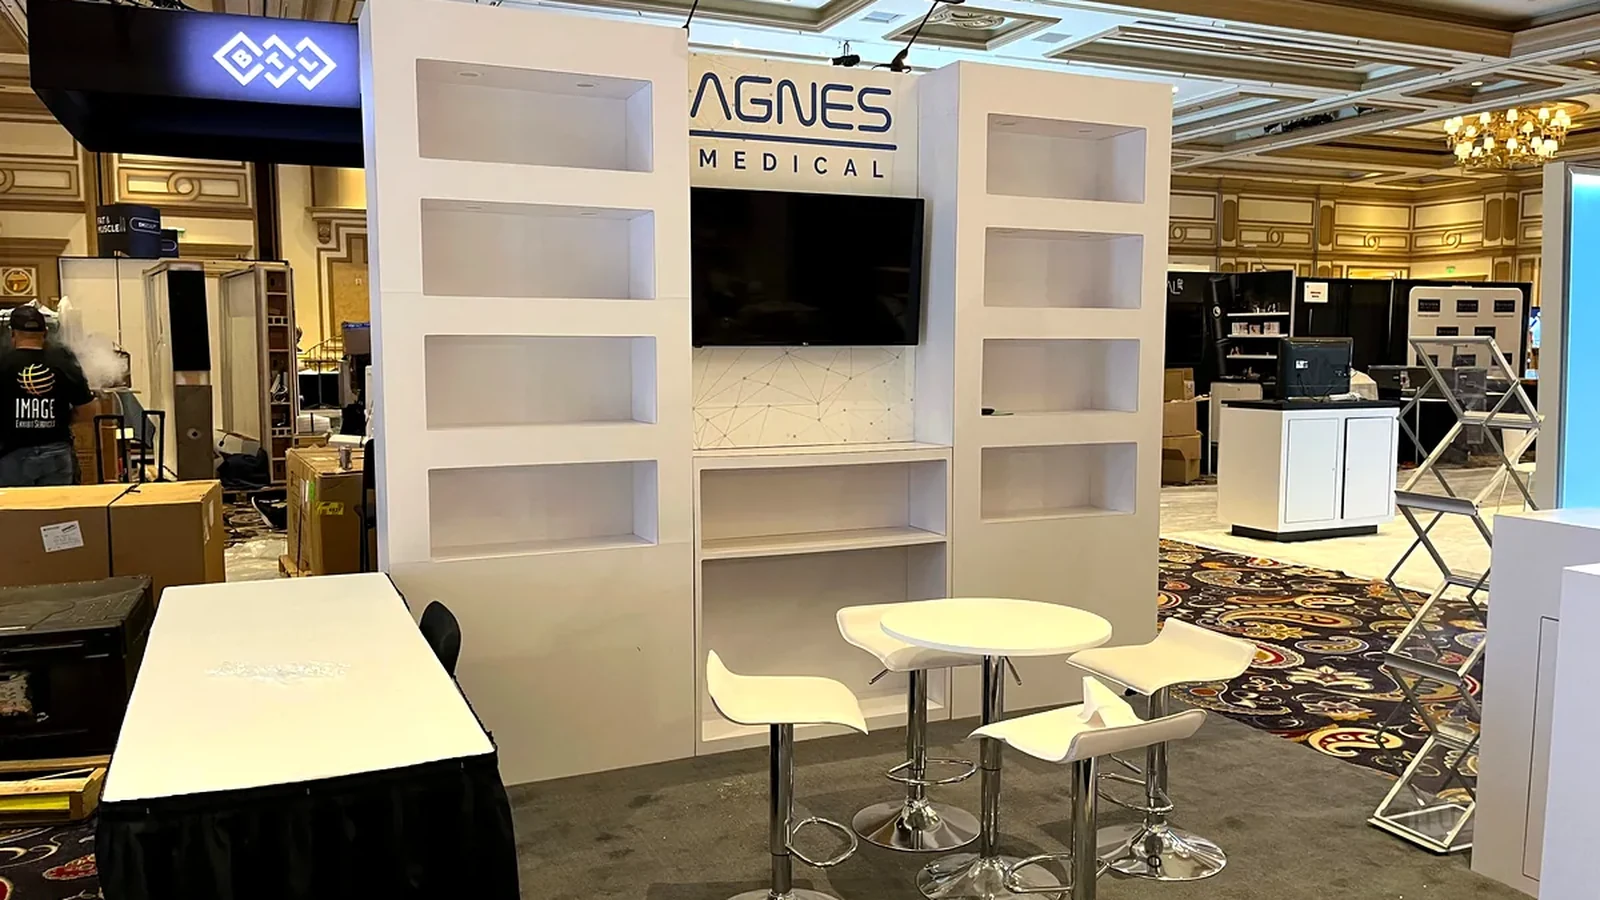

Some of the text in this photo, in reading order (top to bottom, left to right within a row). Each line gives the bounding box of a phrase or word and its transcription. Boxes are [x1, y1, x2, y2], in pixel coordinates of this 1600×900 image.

[690, 72, 892, 133] AGNES
[699, 148, 884, 178] MEDICAL
[15, 398, 55, 419] IMAGE
